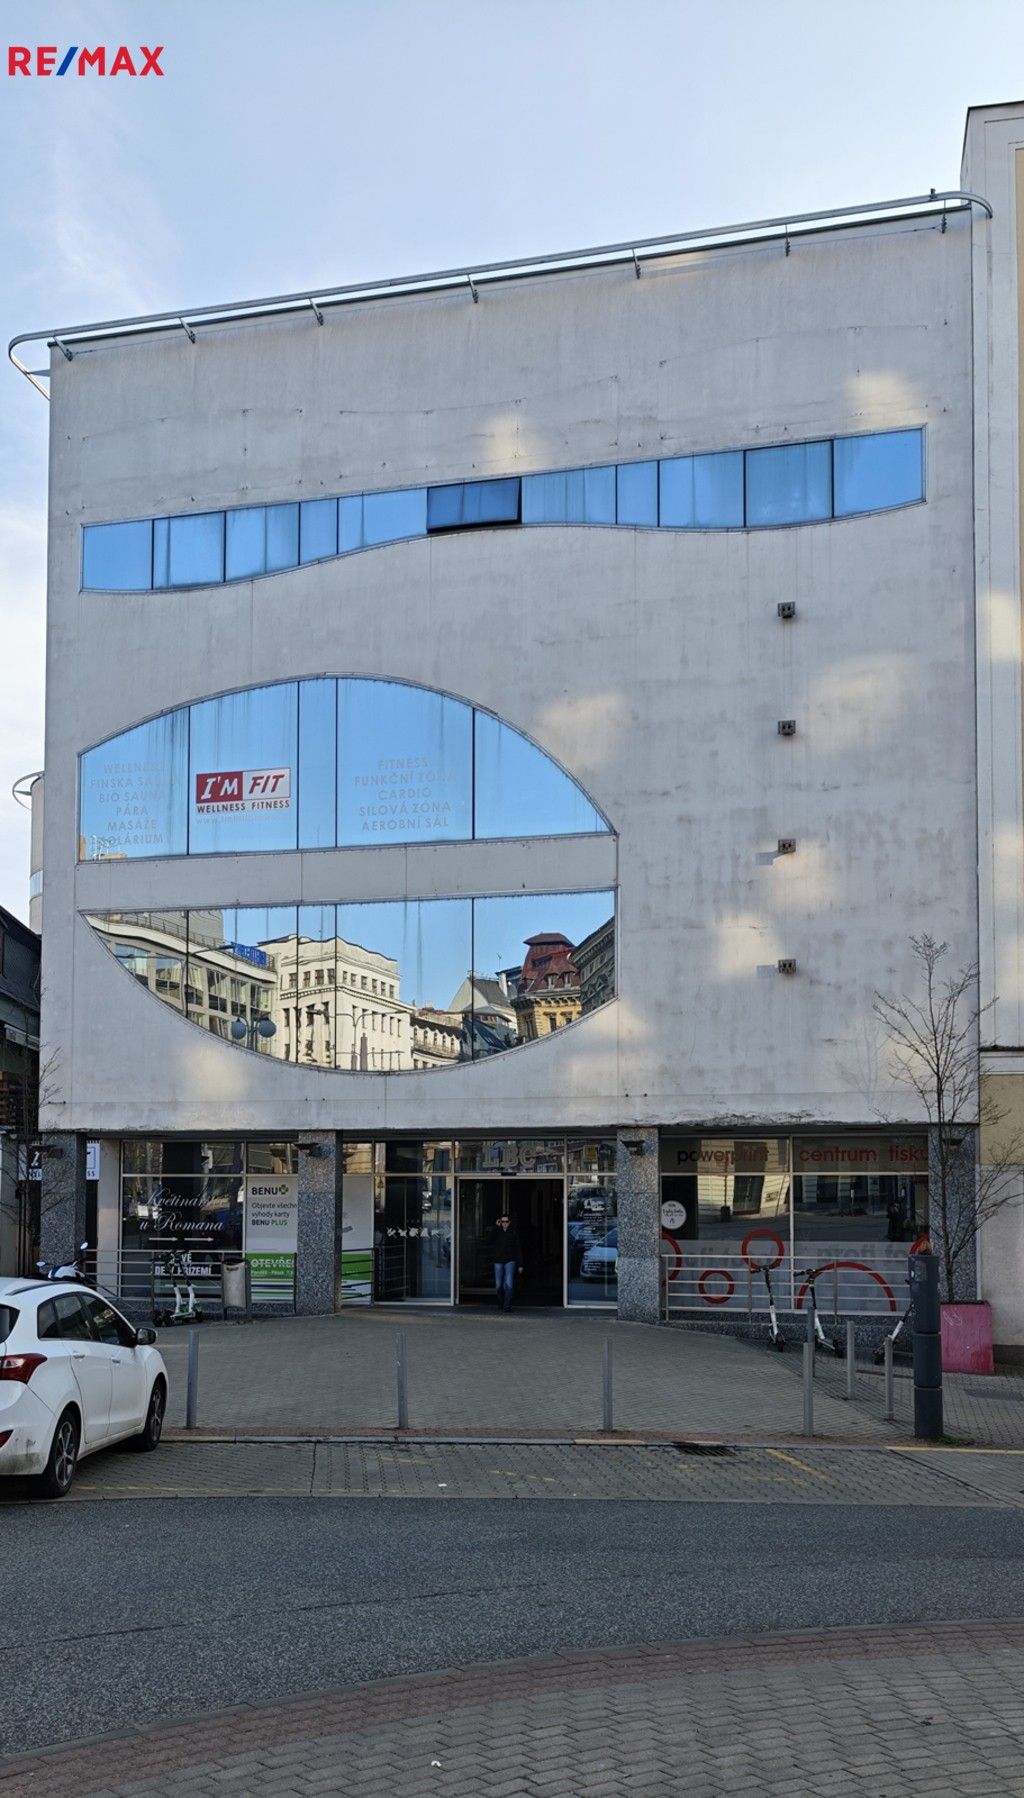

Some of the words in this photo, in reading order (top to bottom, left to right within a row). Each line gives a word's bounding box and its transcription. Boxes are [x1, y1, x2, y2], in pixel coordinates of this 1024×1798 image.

[378, 757, 429, 769] FITNESS
[90, 775, 133, 788] FINSKÁ
[354, 771, 413, 786] FUNKČNÍ
[200, 775, 239, 800] I'M
[248, 774, 285, 795] FIT
[378, 787, 432, 800] CARDIO
[99, 793, 120, 803] BIO
[116, 804, 149, 816] PÁRA
[197, 802, 246, 814] WELLNESS
[251, 800, 290, 810] FITNESS
[359, 801, 408, 816] SILOVÁ
[412, 799, 451, 814] ZÓNA
[361, 816, 420, 832] AEROBNÍ
[424, 815, 449, 828] SÁL
[799, 1146, 877, 1162] centrum
[251, 1187, 278, 1196] BENU
[251, 1202, 276, 1210] Objevte
[154, 1211, 225, 1231] Romana
[274, 1211, 290, 1219] karty
